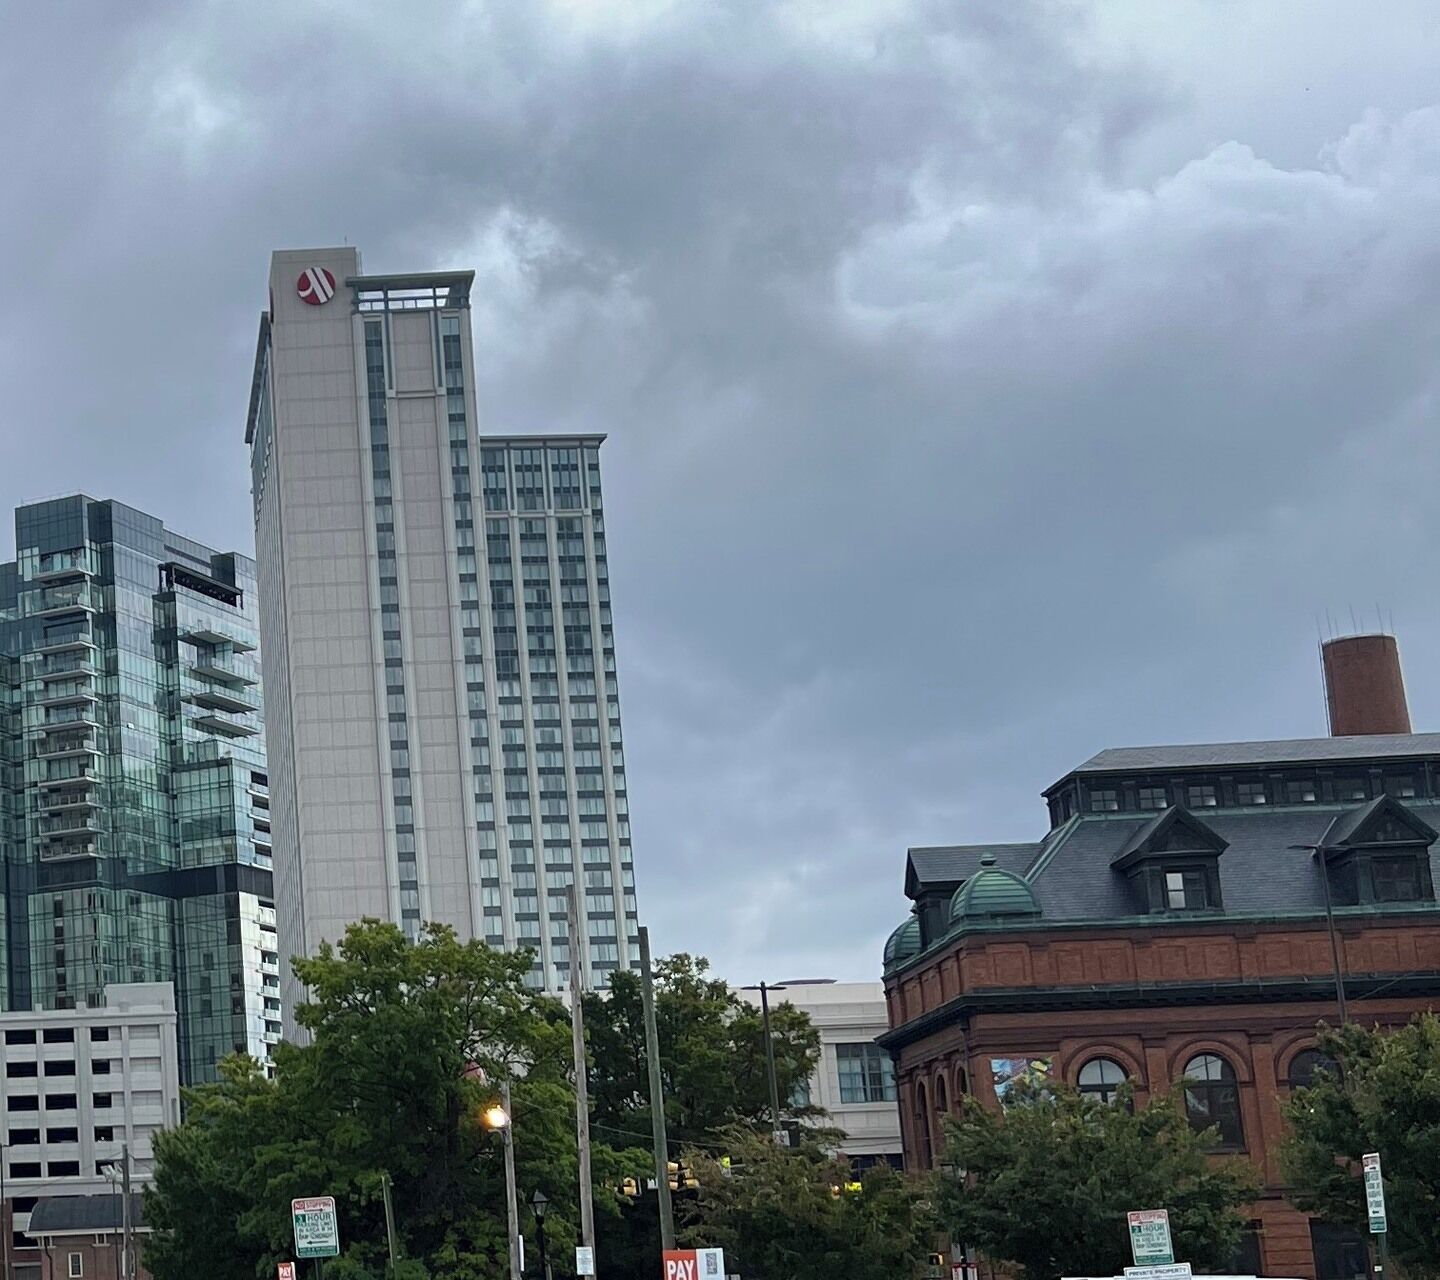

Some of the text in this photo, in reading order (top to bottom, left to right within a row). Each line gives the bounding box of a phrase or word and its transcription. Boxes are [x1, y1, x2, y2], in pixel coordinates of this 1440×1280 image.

[295, 1201, 305, 1210] NO
[307, 1212, 332, 1222] HOUR
[1142, 1223, 1165, 1233] HOUR
[278, 1266, 292, 1278] PAY
[667, 1260, 694, 1280] PAY
